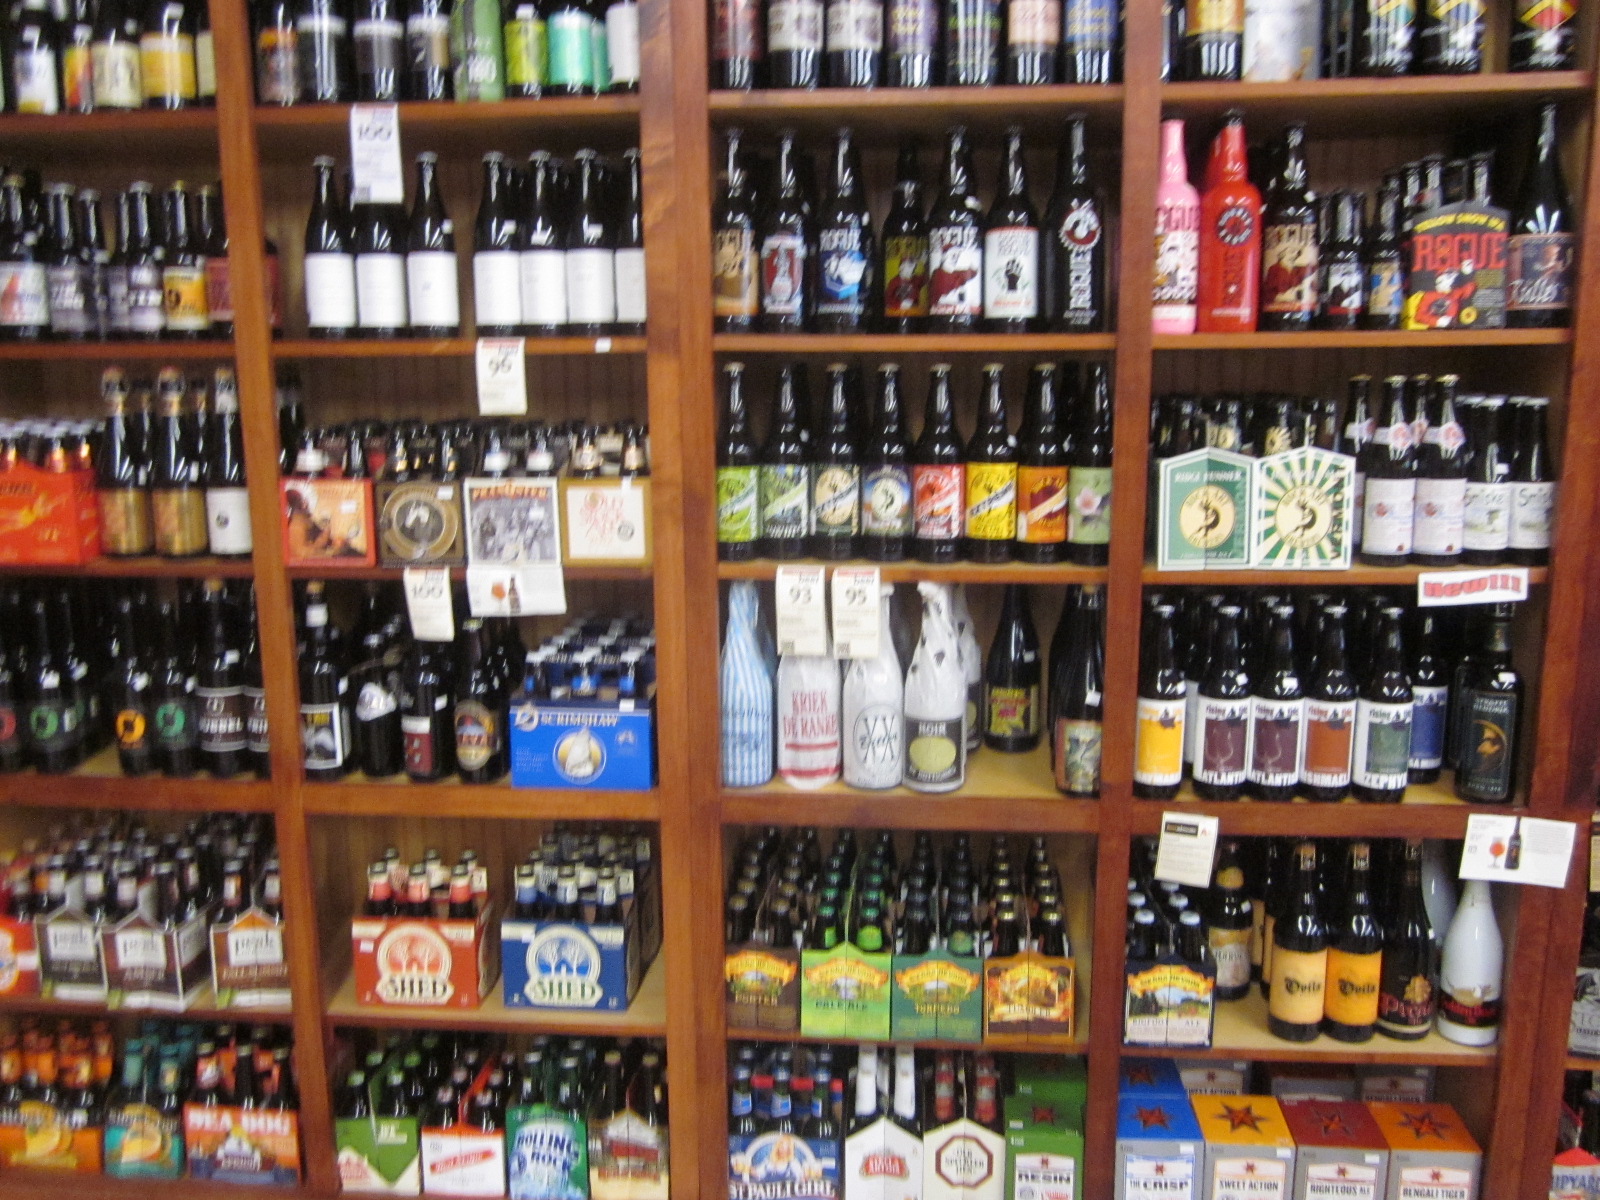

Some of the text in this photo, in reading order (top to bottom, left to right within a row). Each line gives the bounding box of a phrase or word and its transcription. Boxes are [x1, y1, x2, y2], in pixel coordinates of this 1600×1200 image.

[1411, 233, 1508, 272] ROGUE
[411, 584, 444, 599] 100
[789, 584, 811, 603] 93
[845, 587, 867, 606] 95
[541, 711, 618, 727] SCRIMSHAW
[918, 722, 946, 736] NOIR
[389, 977, 448, 998] SHED
[535, 978, 597, 999] SHED
[815, 1000, 844, 1010] PALE
[1018, 1172, 1072, 1184] RESIN
[1143, 1180, 1188, 1191] CRISP
[1219, 1180, 1279, 1191] SWEET ACTION
[747, 1180, 793, 1200] PAULI
[794, 1180, 835, 1199] GIRL
[1310, 1184, 1371, 1195] RIGHTEOUS ALE
[1402, 1188, 1465, 1199] BENGALI TIGER
